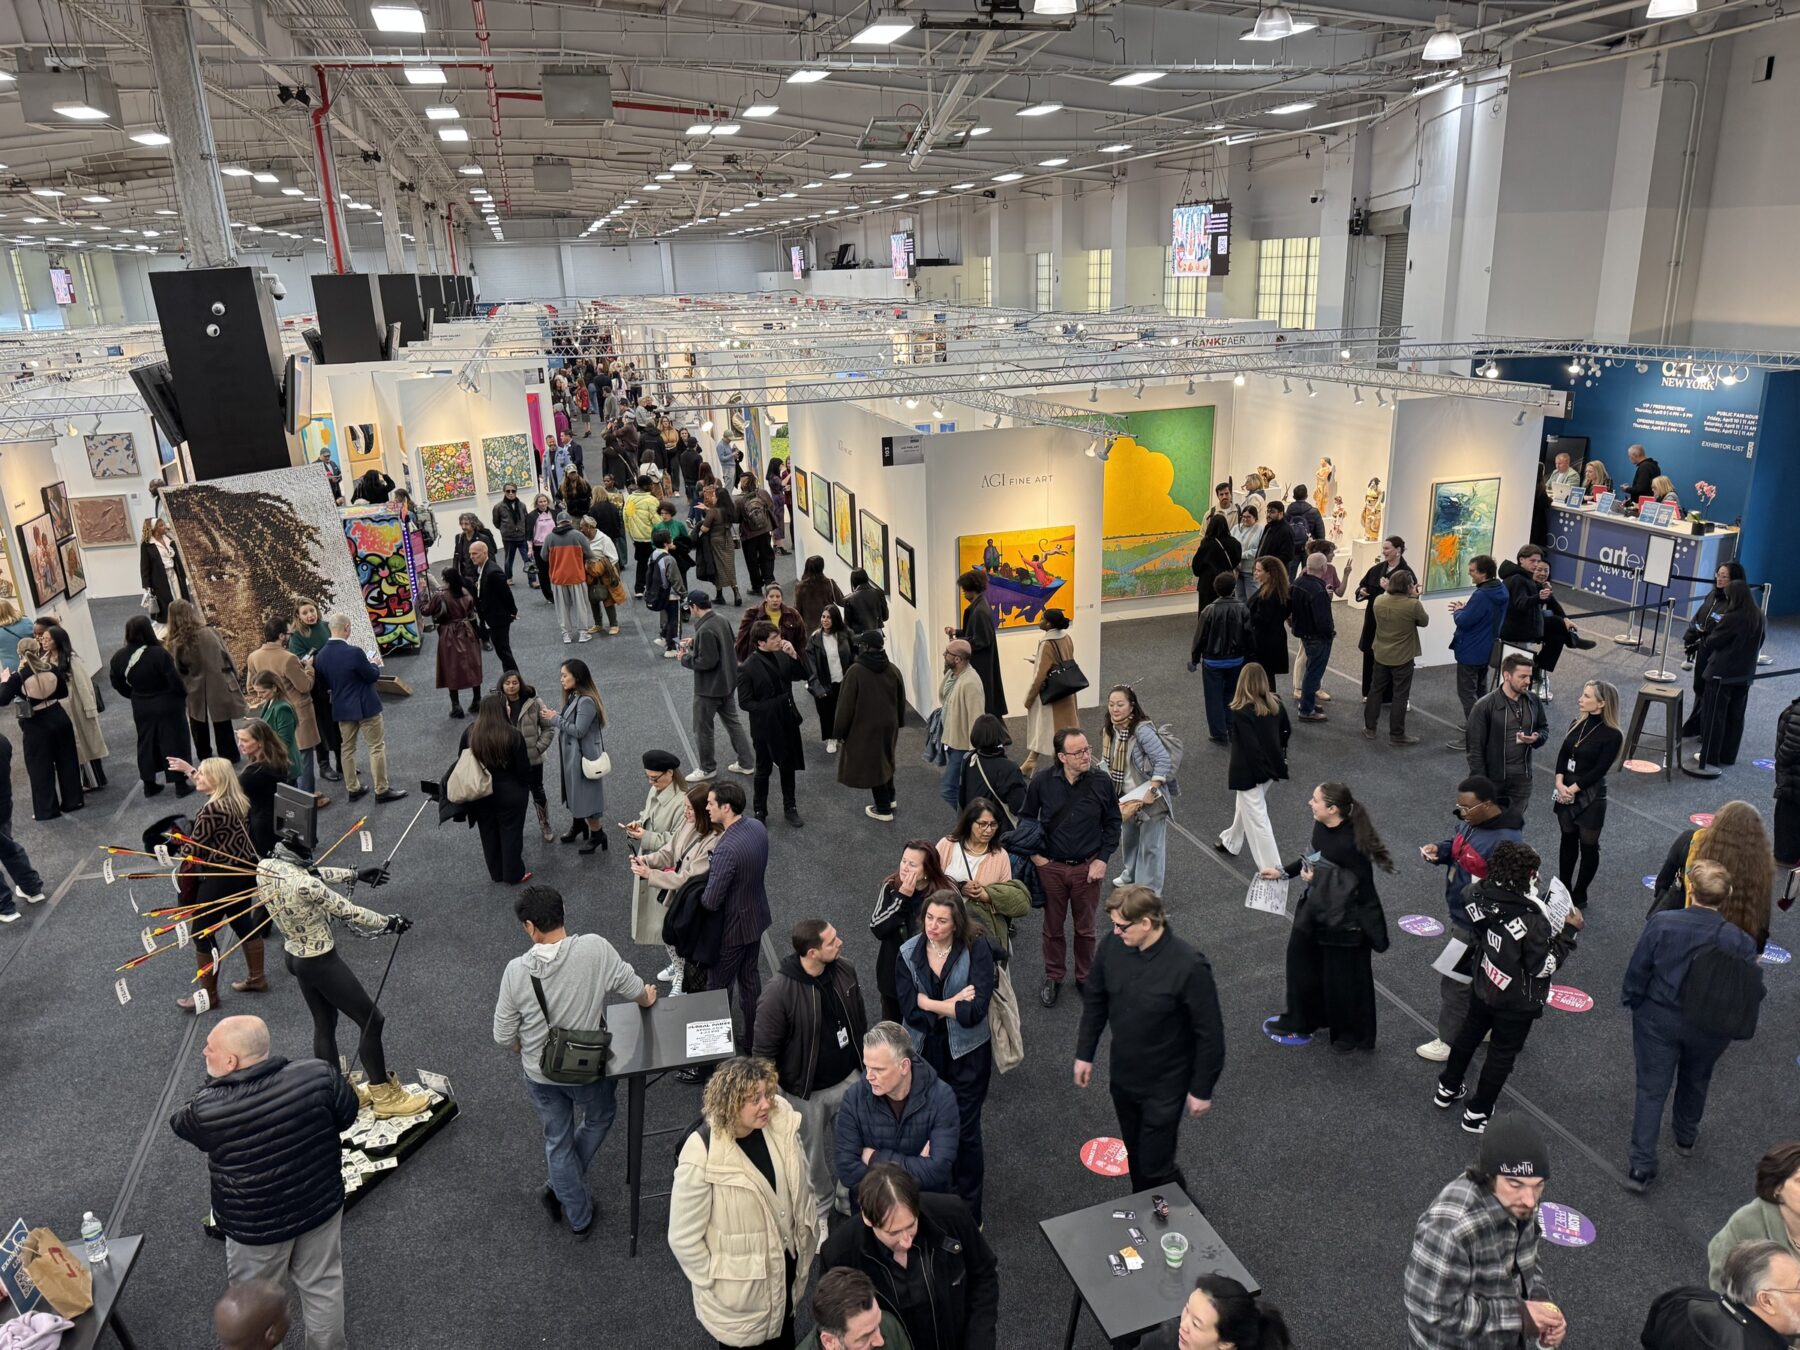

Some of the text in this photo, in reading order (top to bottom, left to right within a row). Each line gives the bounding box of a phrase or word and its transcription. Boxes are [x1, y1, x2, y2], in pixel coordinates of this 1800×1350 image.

[1661, 378, 1716, 390] NEW YORK
[1701, 441, 1731, 450] EXHIBITOR
[981, 473, 1053, 488] AGI FINE ART
[1598, 565, 1620, 576] NEW
[1484, 960, 1509, 986] ART
